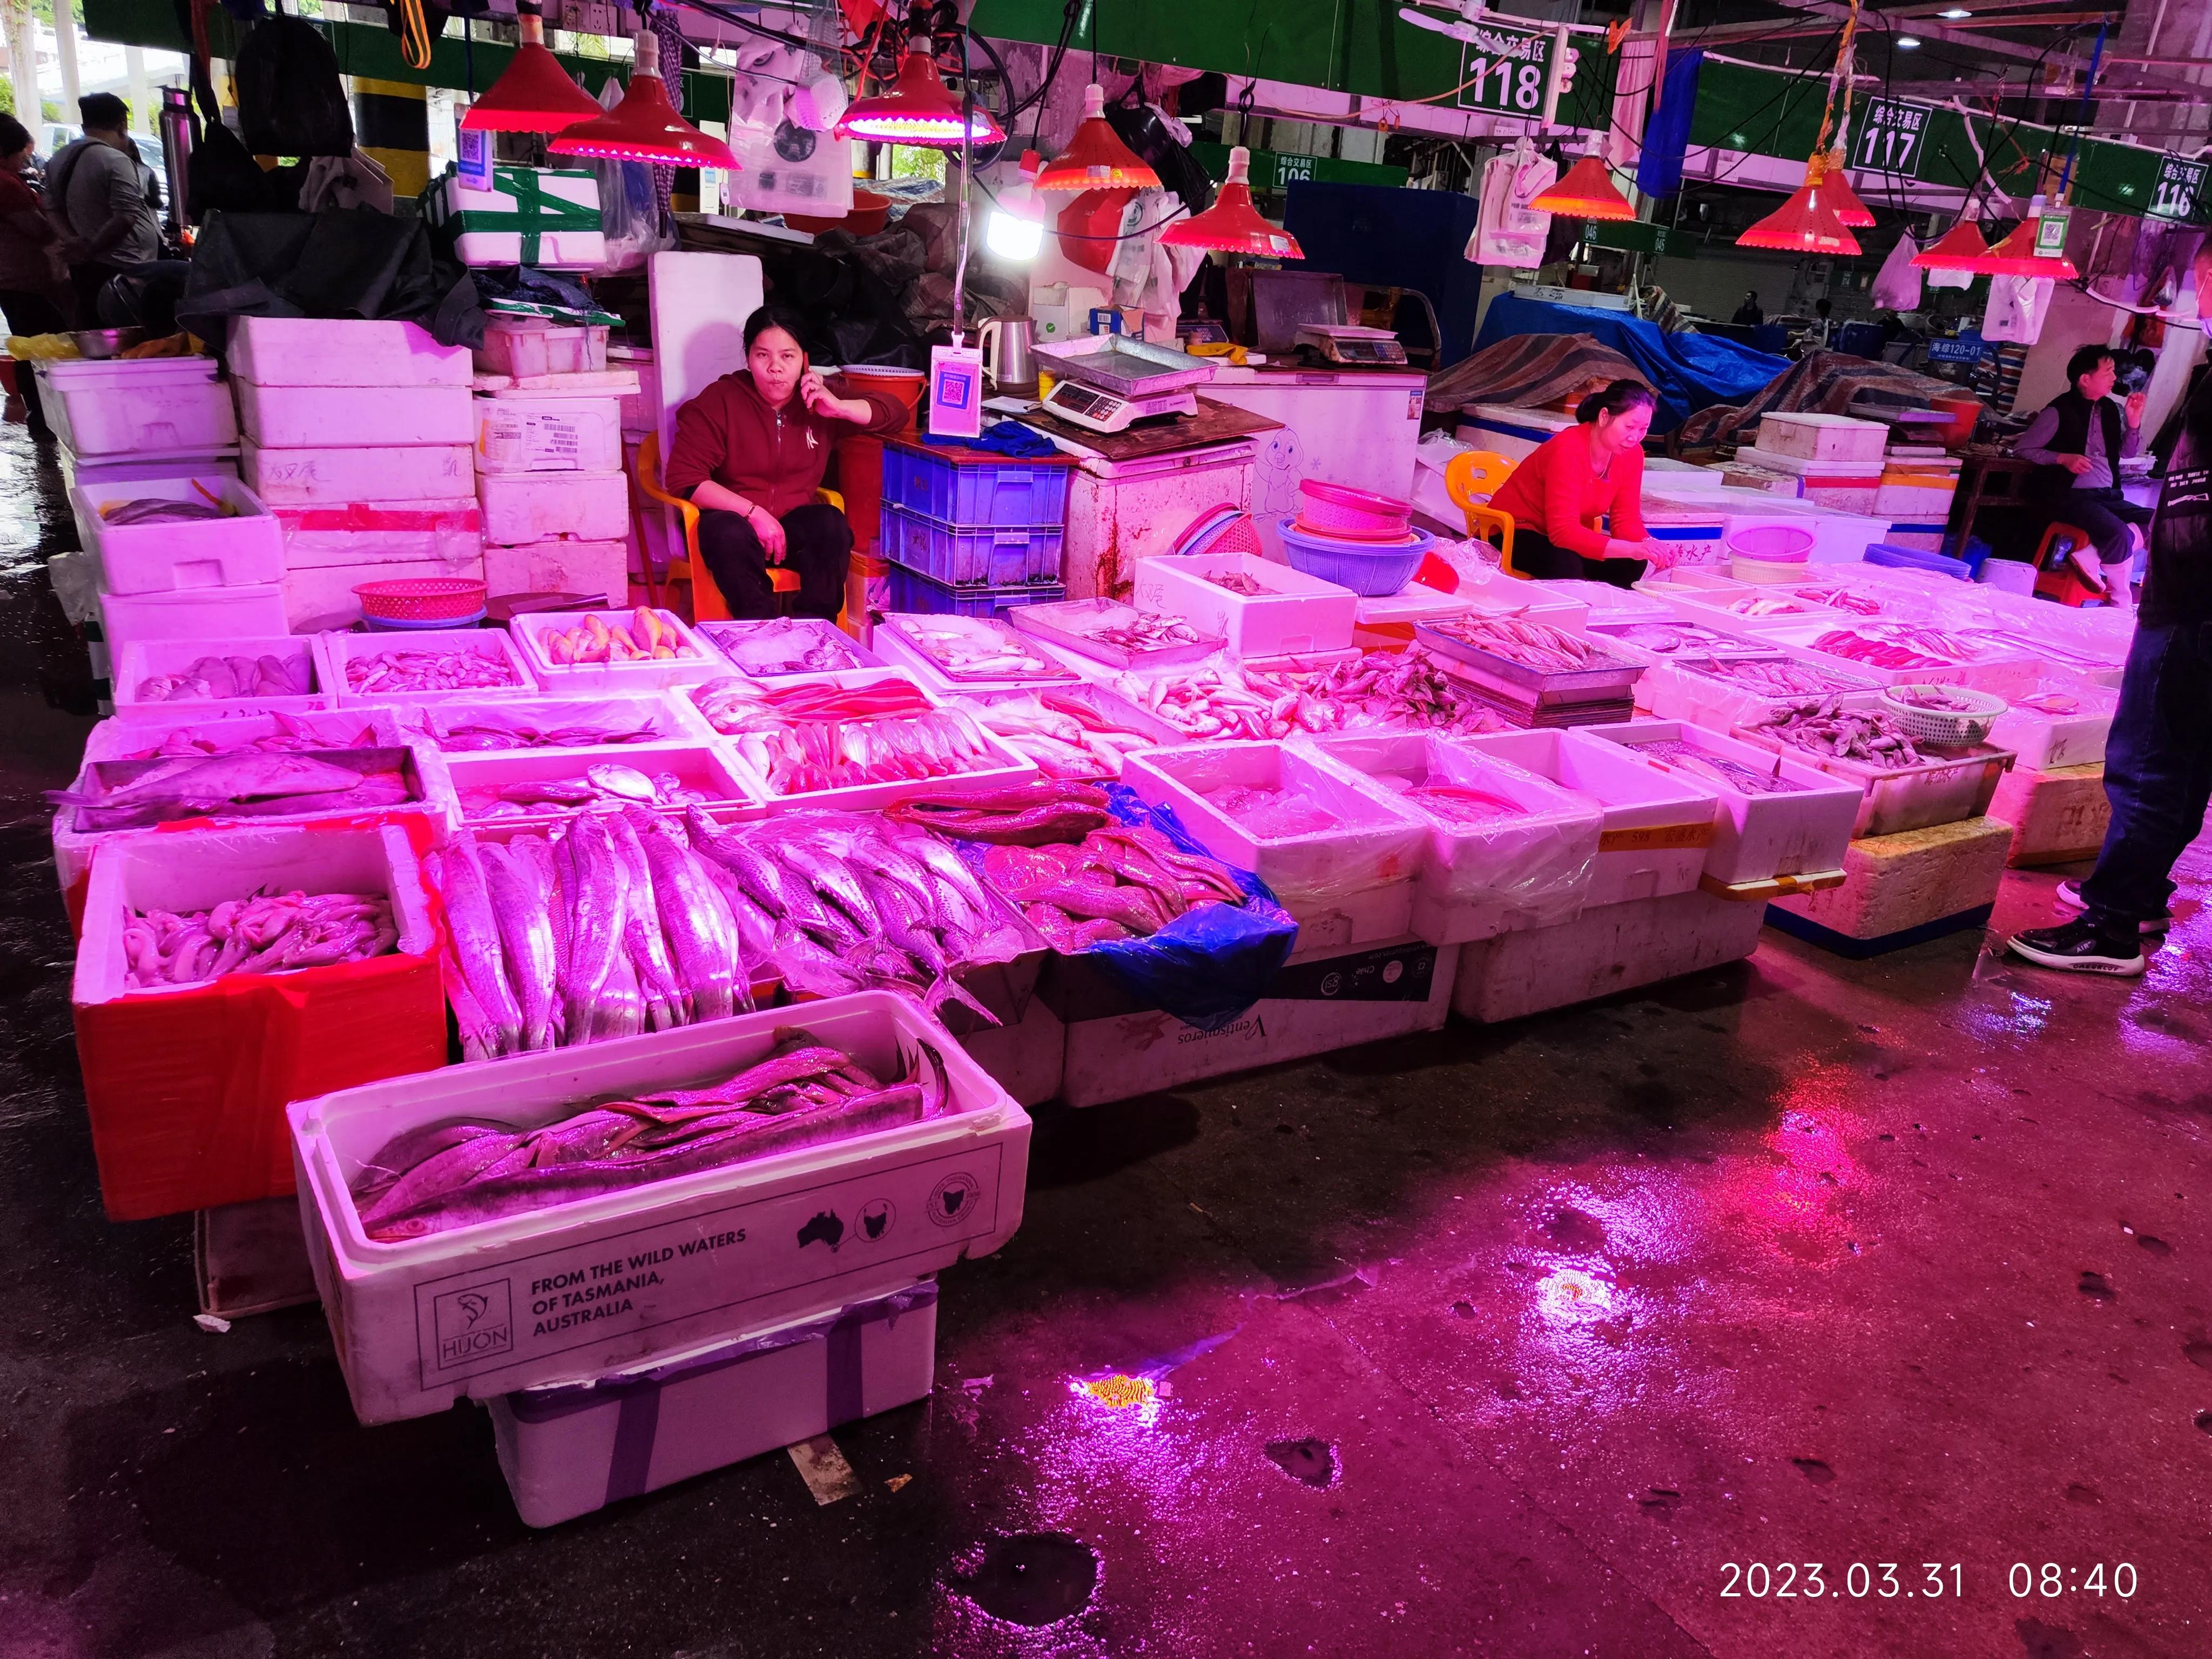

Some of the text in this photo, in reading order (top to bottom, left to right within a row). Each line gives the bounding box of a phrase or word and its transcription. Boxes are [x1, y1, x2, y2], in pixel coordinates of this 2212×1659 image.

[1469, 57, 1541, 110] 118
[1872, 104, 1923, 131] 综合交易区
[1280, 156, 1312, 168] 综合交易区
[1864, 127, 1916, 169] 117
[2156, 181, 2195, 217] 116
[1585, 224, 1597, 240] 046
[1631, 831, 1651, 842] 598
[1355, 965, 1375, 975] Chile
[1177, 1014, 1267, 1044] Ventisqueros
[531, 1228, 746, 1295] FROM THE WILD WATERS
[532, 1270, 665, 1315] OF TASMANIA,
[532, 1298, 633, 1337] AUSTRALIA
